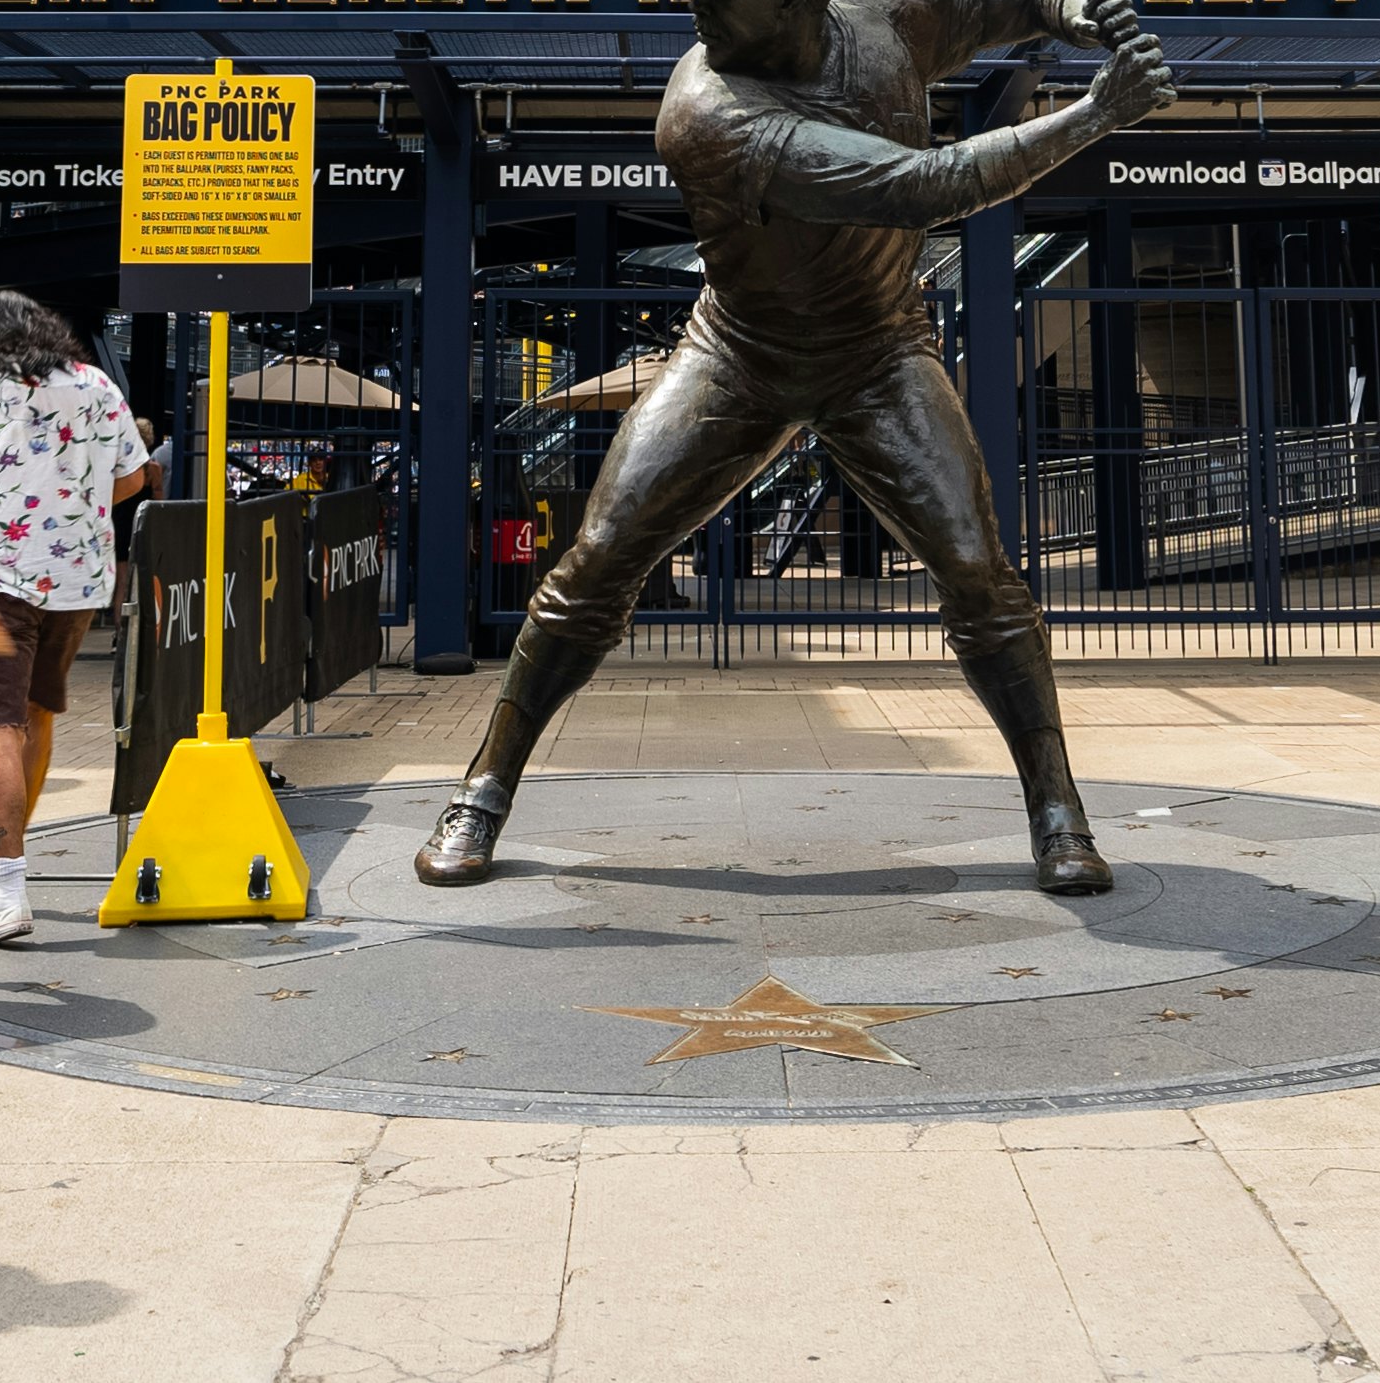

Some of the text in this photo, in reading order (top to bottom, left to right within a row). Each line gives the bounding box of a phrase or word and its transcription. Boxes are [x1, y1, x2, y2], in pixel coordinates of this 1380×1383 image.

[160, 85, 281, 99] PNC PARK
[142, 101, 297, 142] BAG POLICY
[143, 151, 299, 160] EACH GUEST IS PERMITTED TO BRING ONE BAG
[143, 164, 160, 174] INTO
[161, 164, 175, 174] THE
[176, 164, 211, 174] BALLPARK
[247, 164, 269, 174] FANNY
[271, 164, 295, 174] PACKS,
[499, 164, 678, 187] HAVE DIGIT
[1108, 160, 1247, 184] Download
[54, 163, 124, 188] Ticke
[328, 163, 405, 191] Entry
[142, 178, 186, 187] BACKPACKS,
[207, 178, 242, 187] PROVIDED
[243, 178, 260, 187] THAT
[262, 178, 275, 187] THE
[277, 178, 291, 187] BAG
[292, 178, 299, 187] IS
[142, 191, 183, 201] SOFT-SIDED
[184, 191, 199, 201] AND
[214, 191, 220, 201] X
[236, 191, 241, 201] X
[252, 191, 263, 201] OR
[264, 191, 298, 201] SMALLER.
[141, 212, 302, 221] BAGS EXCEEDING THESE DIMENSIONS WILL NOT
[141, 225, 271, 235] BE PERMITTED INSIDE THE BALLPARK.
[140, 246, 262, 255] ALL BAGS ARE SUBJECT TO SEARCH.
[330, 534, 380, 593] PNC PARK
[260, 514, 278, 664] P
[165, 579, 199, 649] PNC
